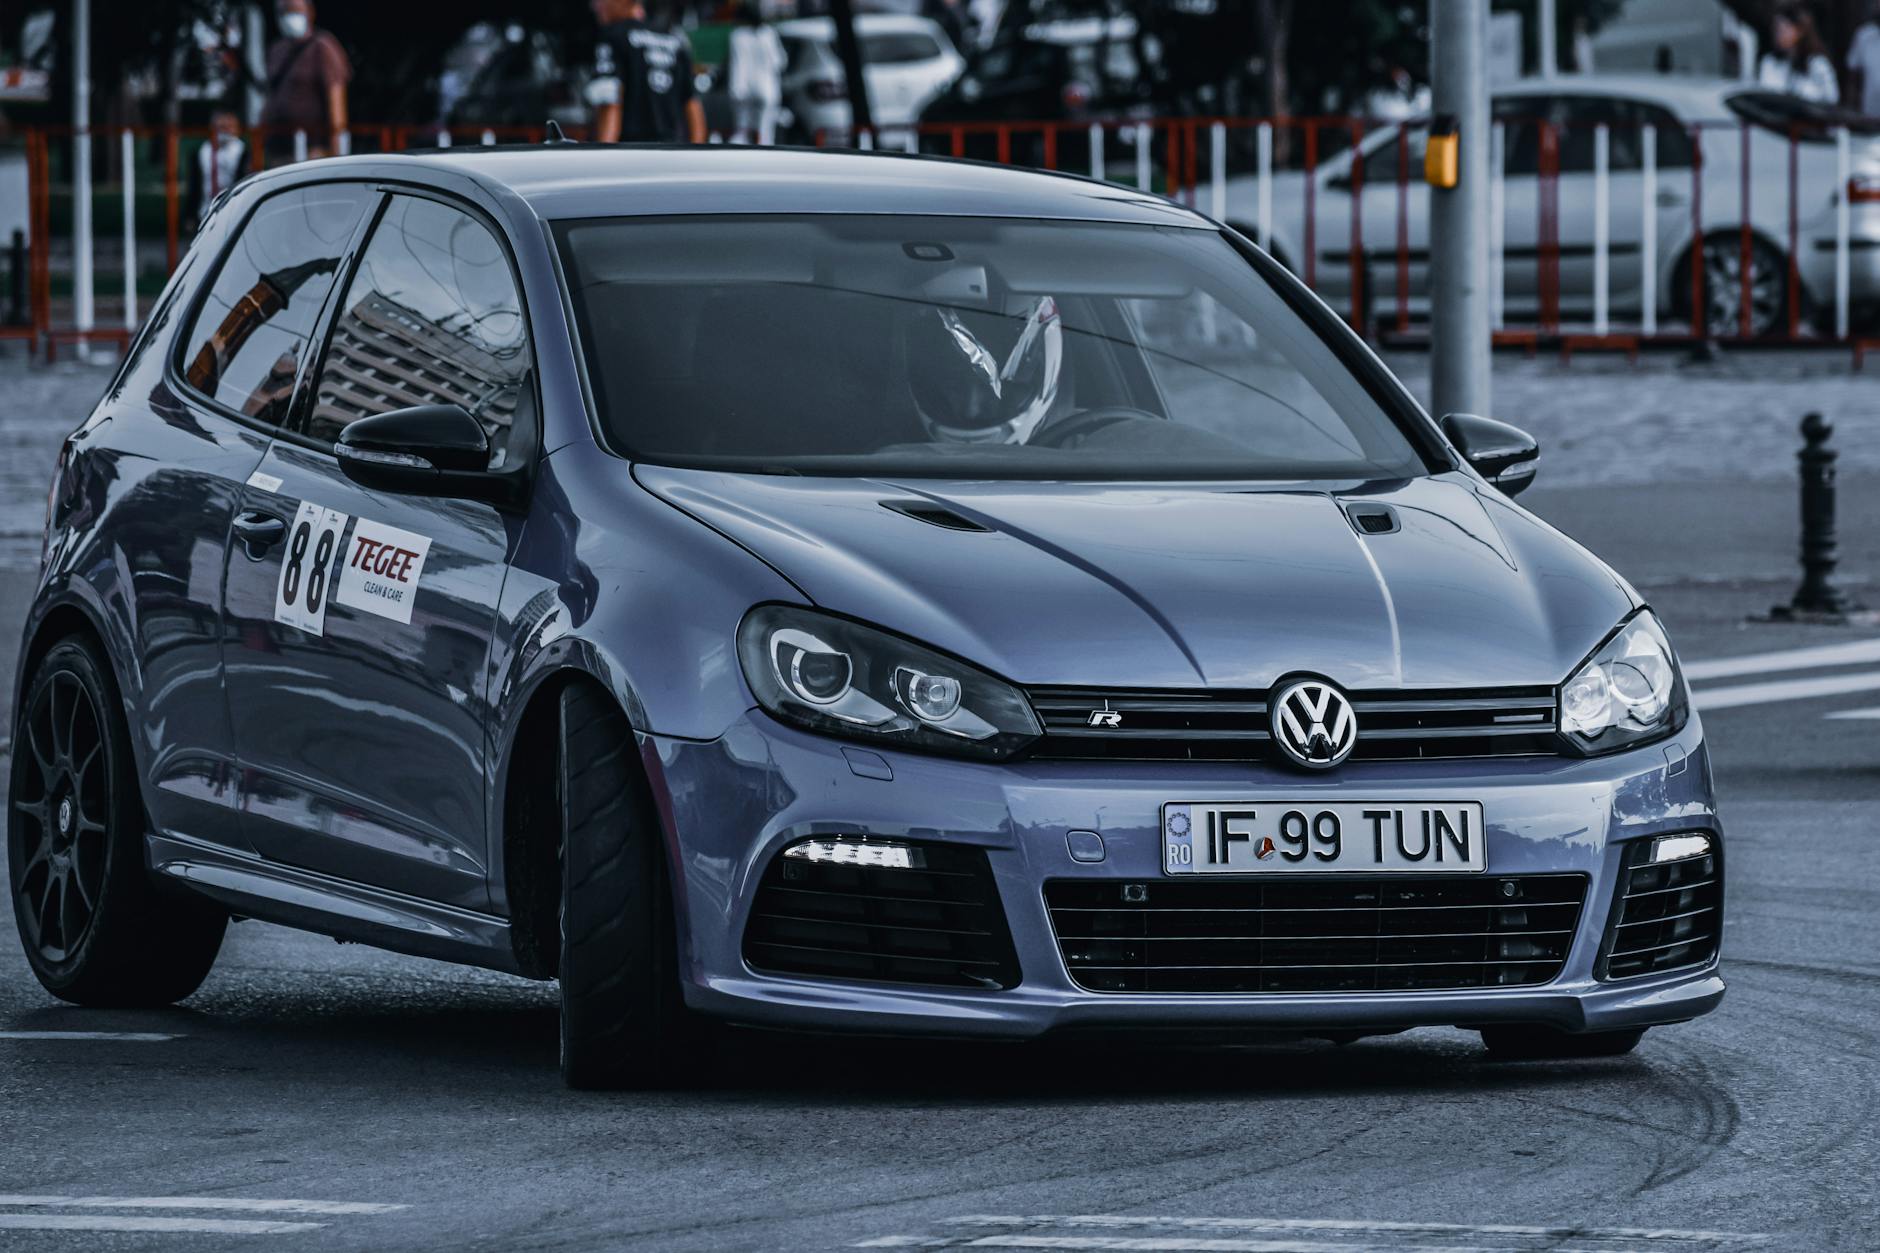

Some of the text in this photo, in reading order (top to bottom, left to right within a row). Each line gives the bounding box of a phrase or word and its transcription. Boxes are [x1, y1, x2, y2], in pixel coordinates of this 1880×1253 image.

[282, 521, 335, 614] 88
[351, 536, 420, 583] TEGEE
[364, 581, 384, 597] CLEAN
[387, 588, 403, 602] CARE
[1087, 710, 1122, 728] R
[1275, 683, 1353, 764] VW
[1168, 844, 1192, 865] RO
[1207, 809, 1470, 864] IF 99 TUN
